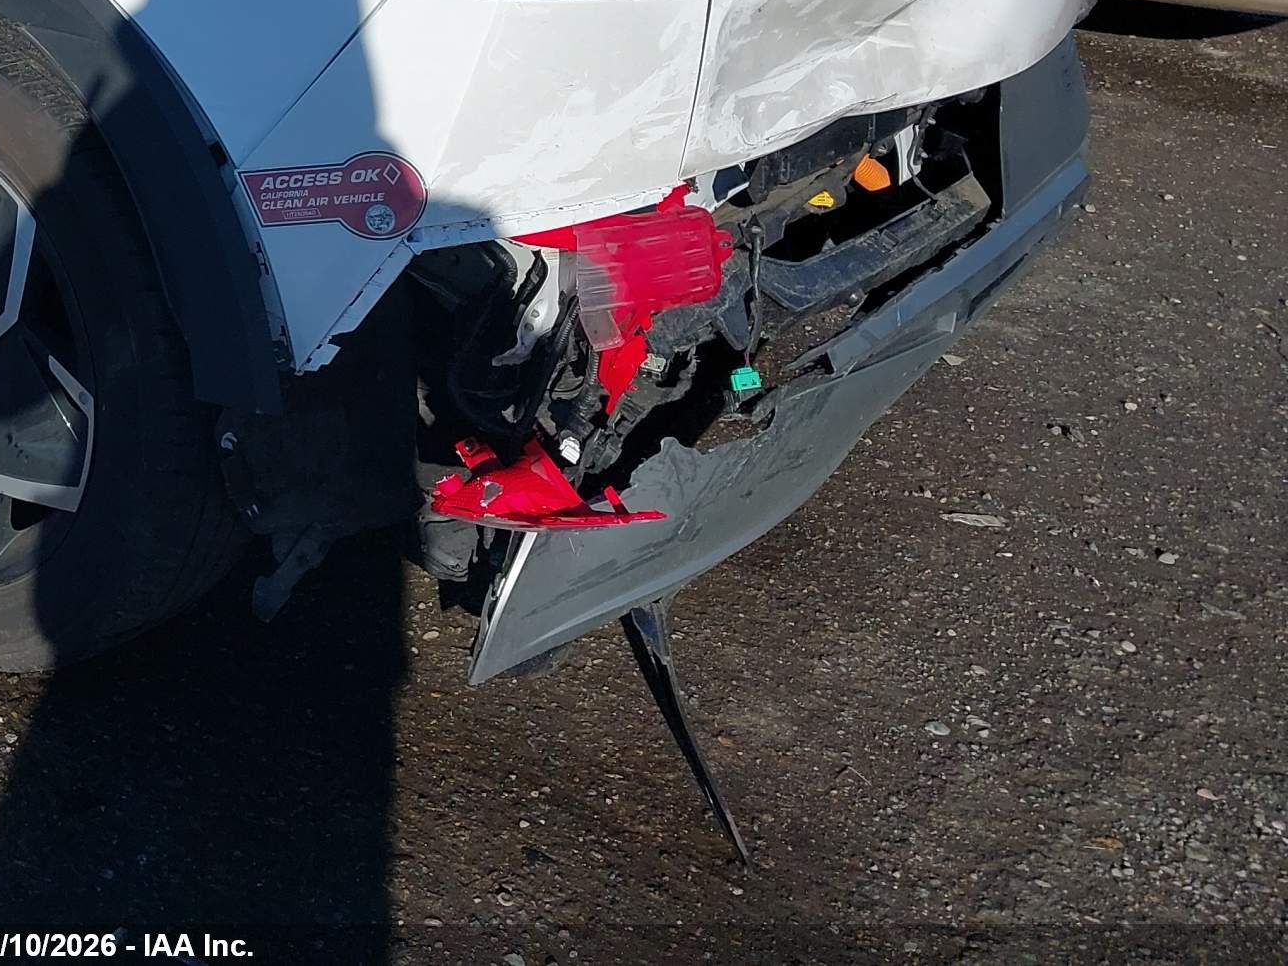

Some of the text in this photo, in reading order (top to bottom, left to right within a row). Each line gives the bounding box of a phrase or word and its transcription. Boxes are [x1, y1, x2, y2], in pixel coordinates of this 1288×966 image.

[260, 168, 382, 190] ACCESS OK
[260, 189, 309, 200] CALIFORNIA
[261, 192, 385, 210] CLEAN AIR VEHICLE
